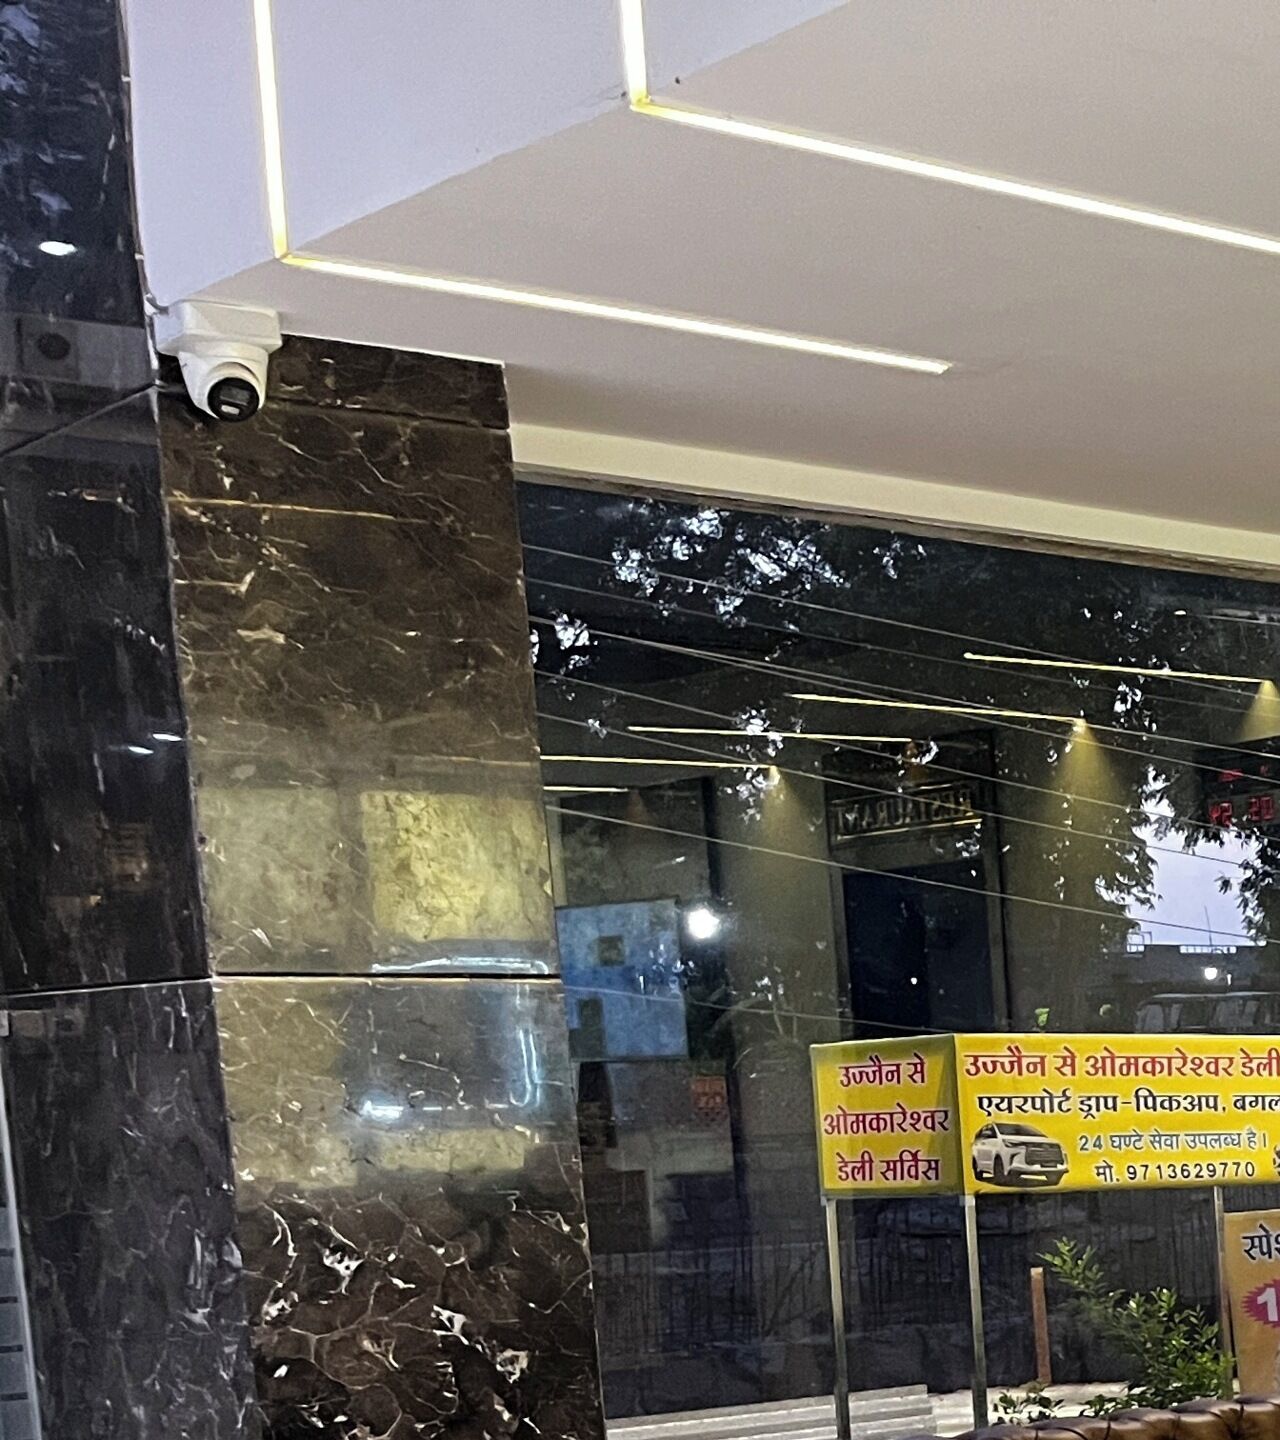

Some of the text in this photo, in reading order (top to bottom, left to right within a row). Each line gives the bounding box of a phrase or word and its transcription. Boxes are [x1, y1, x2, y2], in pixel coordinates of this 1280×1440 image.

[839, 1053, 926, 1087] उज्जैन से
[964, 1045, 1046, 1077] उज्जैन
[1054, 1046, 1076, 1077] से
[1085, 1046, 1235, 1077] ओमकारेश्वर
[1240, 1047, 1280, 1077] डेली
[824, 1102, 950, 1135] ओमकारेश्वर
[977, 1088, 1072, 1117] एयरपोर्ट
[1079, 1135, 1103, 1152] 24
[1109, 1129, 1144, 1151] घण्टे
[1149, 1129, 1179, 1150] सेवा
[1185, 1132, 1241, 1150] उपलब्ध
[836, 1149, 941, 1182] डेली सर्विस
[1095, 1160, 1256, 1183] मो. 9713629770
